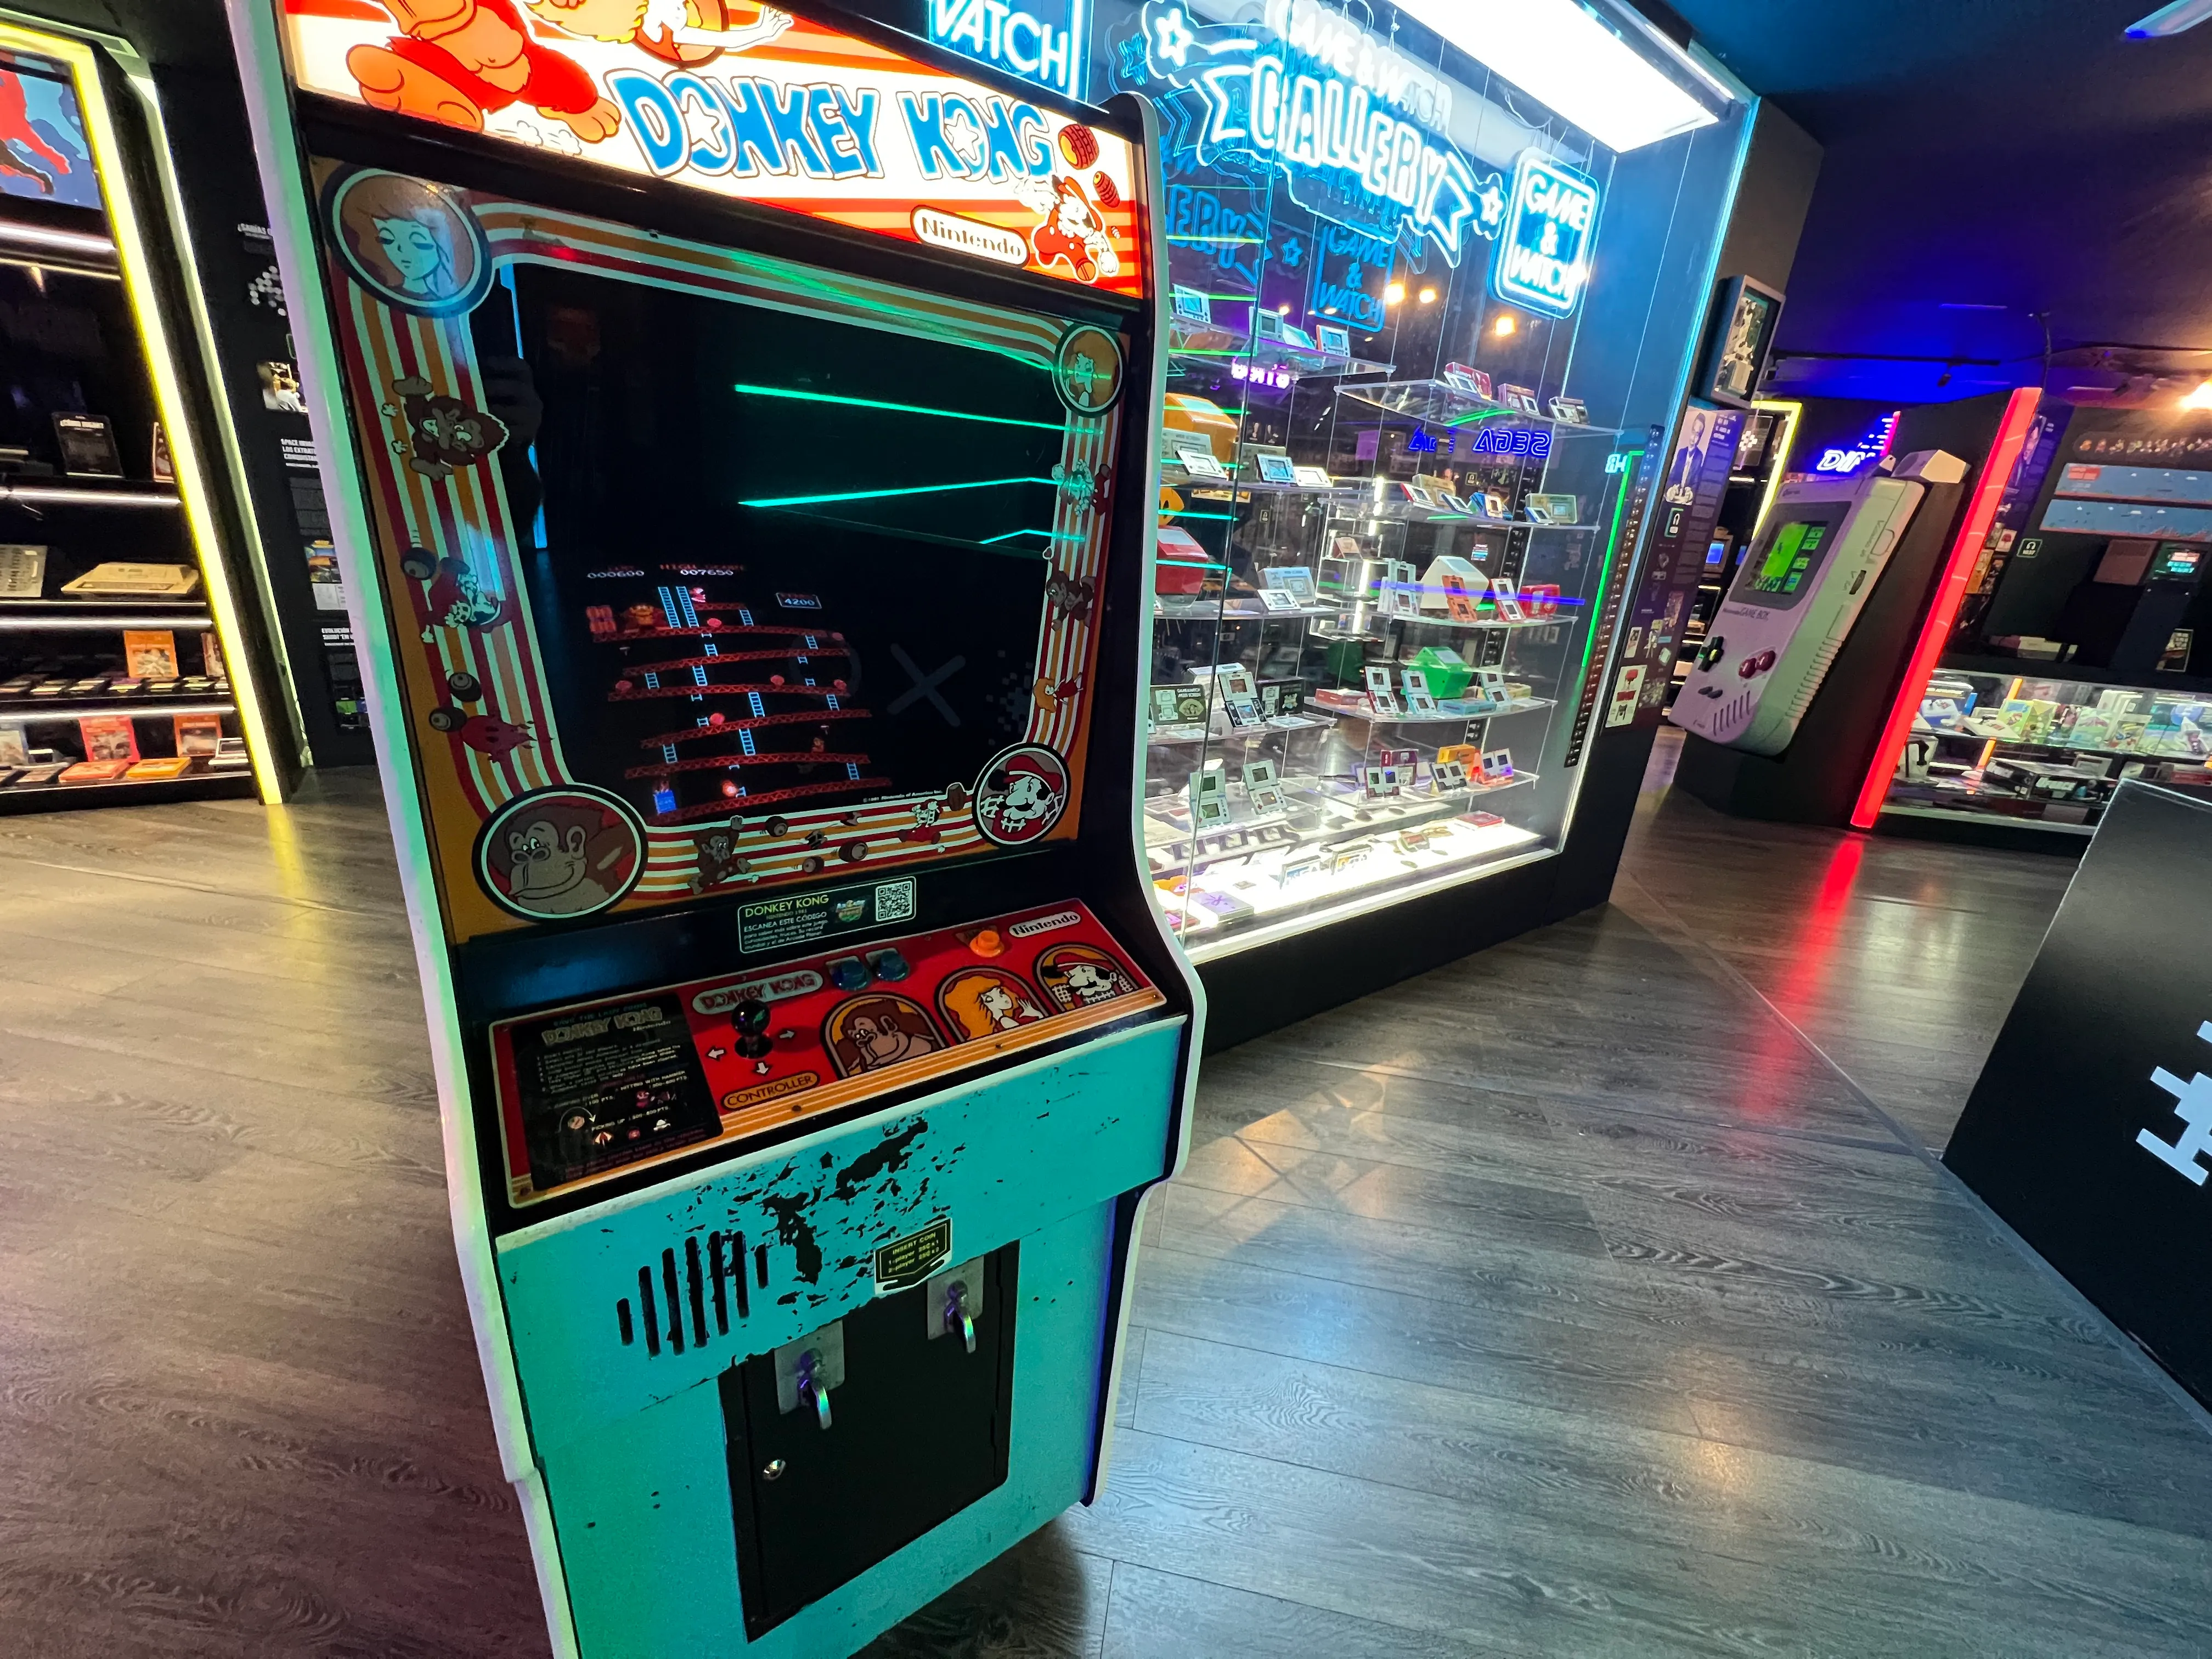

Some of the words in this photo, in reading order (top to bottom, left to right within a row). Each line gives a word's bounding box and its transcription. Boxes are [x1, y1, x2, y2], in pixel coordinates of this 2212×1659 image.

[605, 69, 884, 179] DONKEY
[896, 90, 1057, 182] KONG
[1525, 174, 1590, 231] GAME
[922, 216, 1022, 259] Nintendo
[1328, 225, 1391, 268] GAME
[1540, 222, 1558, 256] &
[1346, 262, 1363, 289] &
[1510, 244, 1577, 298] WATCH
[1319, 282, 1384, 325] WATCH
[586, 569, 645, 579] 000600
[784, 598, 815, 606] 4200
[744, 921, 777, 933] ESCANEA
[779, 917, 794, 926] ESTE
[796, 911, 827, 923] CÓDIGO
[745, 900, 793, 918] DONKEY
[796, 895, 829, 909] KONG
[1012, 913, 1079, 936] Nintendo
[699, 984, 766, 1010] DONKEY
[769, 973, 816, 994] KONG
[541, 1017, 610, 1047] DONKEY
[613, 1006, 662, 1029] KONG
[727, 1075, 812, 1107] CONTROLLER
[892, 1240, 917, 1255] INSERT
[919, 1232, 936, 1243] COIN
